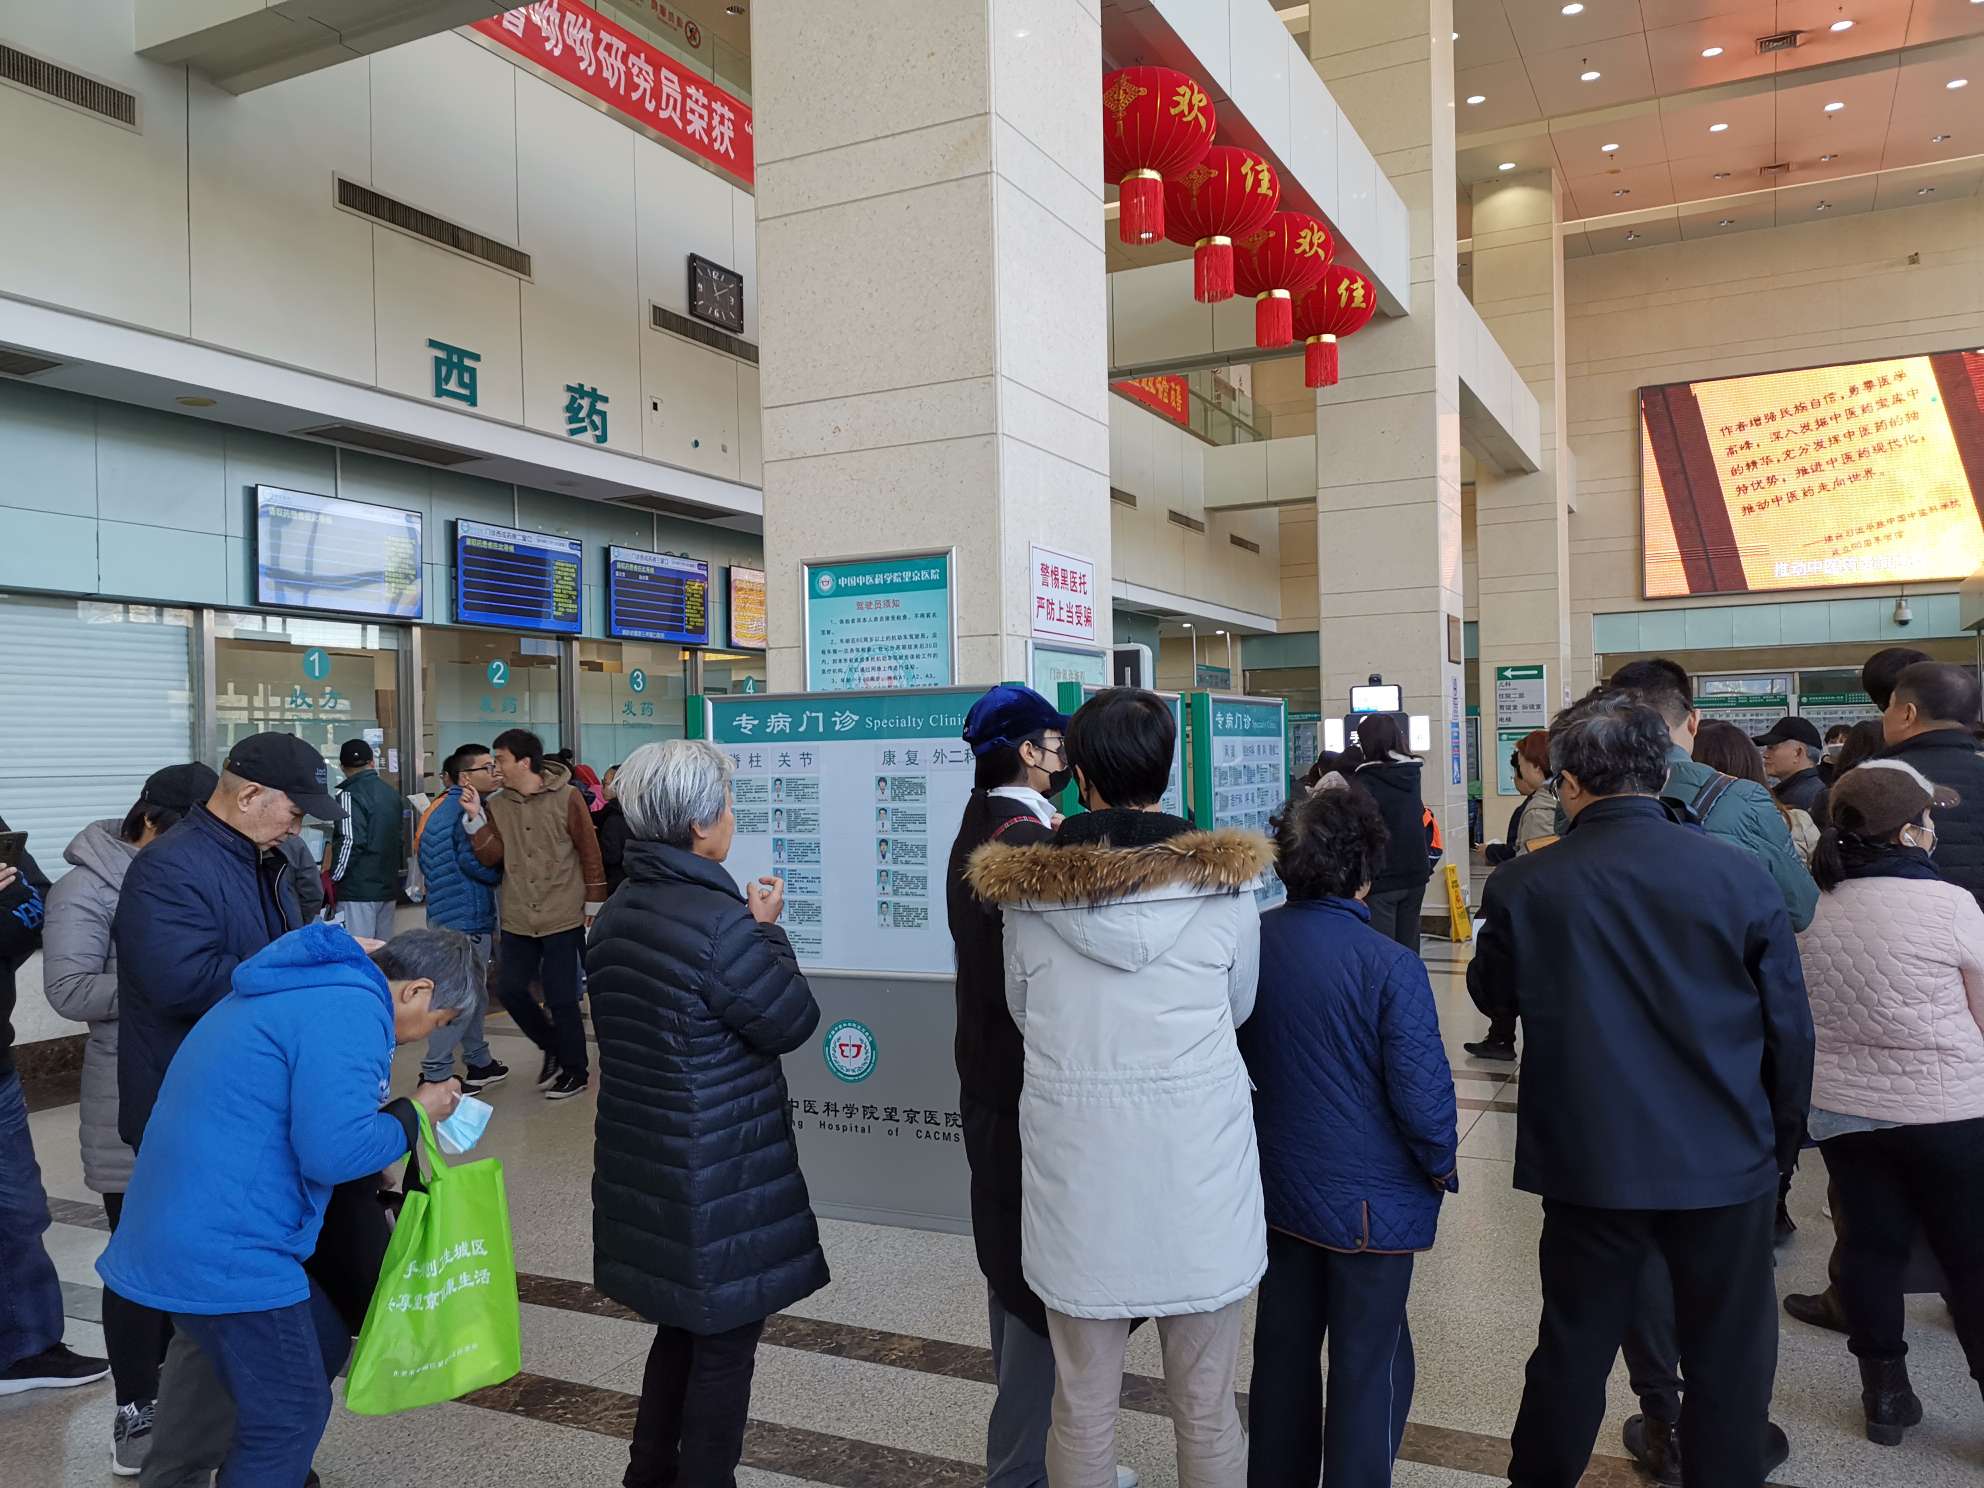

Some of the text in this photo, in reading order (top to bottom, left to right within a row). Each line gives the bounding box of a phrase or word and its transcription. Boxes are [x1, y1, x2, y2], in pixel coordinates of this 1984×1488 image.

[1170, 80, 1207, 132] 欢
[1241, 158, 1273, 197] 佳
[1294, 221, 1326, 261] 欢
[1337, 276, 1367, 309] 佳
[1040, 562, 1087, 595] 警惕黑医托
[1036, 596, 1092, 628] 严防上当受骗
[309, 652, 320, 677] 1
[492, 661, 505, 684] 2
[633, 671, 643, 692] 3
[745, 679, 754, 695] 4
[732, 709, 860, 735] 专病门诊
[865, 714, 924, 730] Specialty
[778, 751, 813, 768] 关节
[882, 750, 920, 766] 康复
[819, 1120, 871, 1134] Hospital
[887, 1127, 899, 1136] of
[916, 1129, 961, 1143] CACMS
